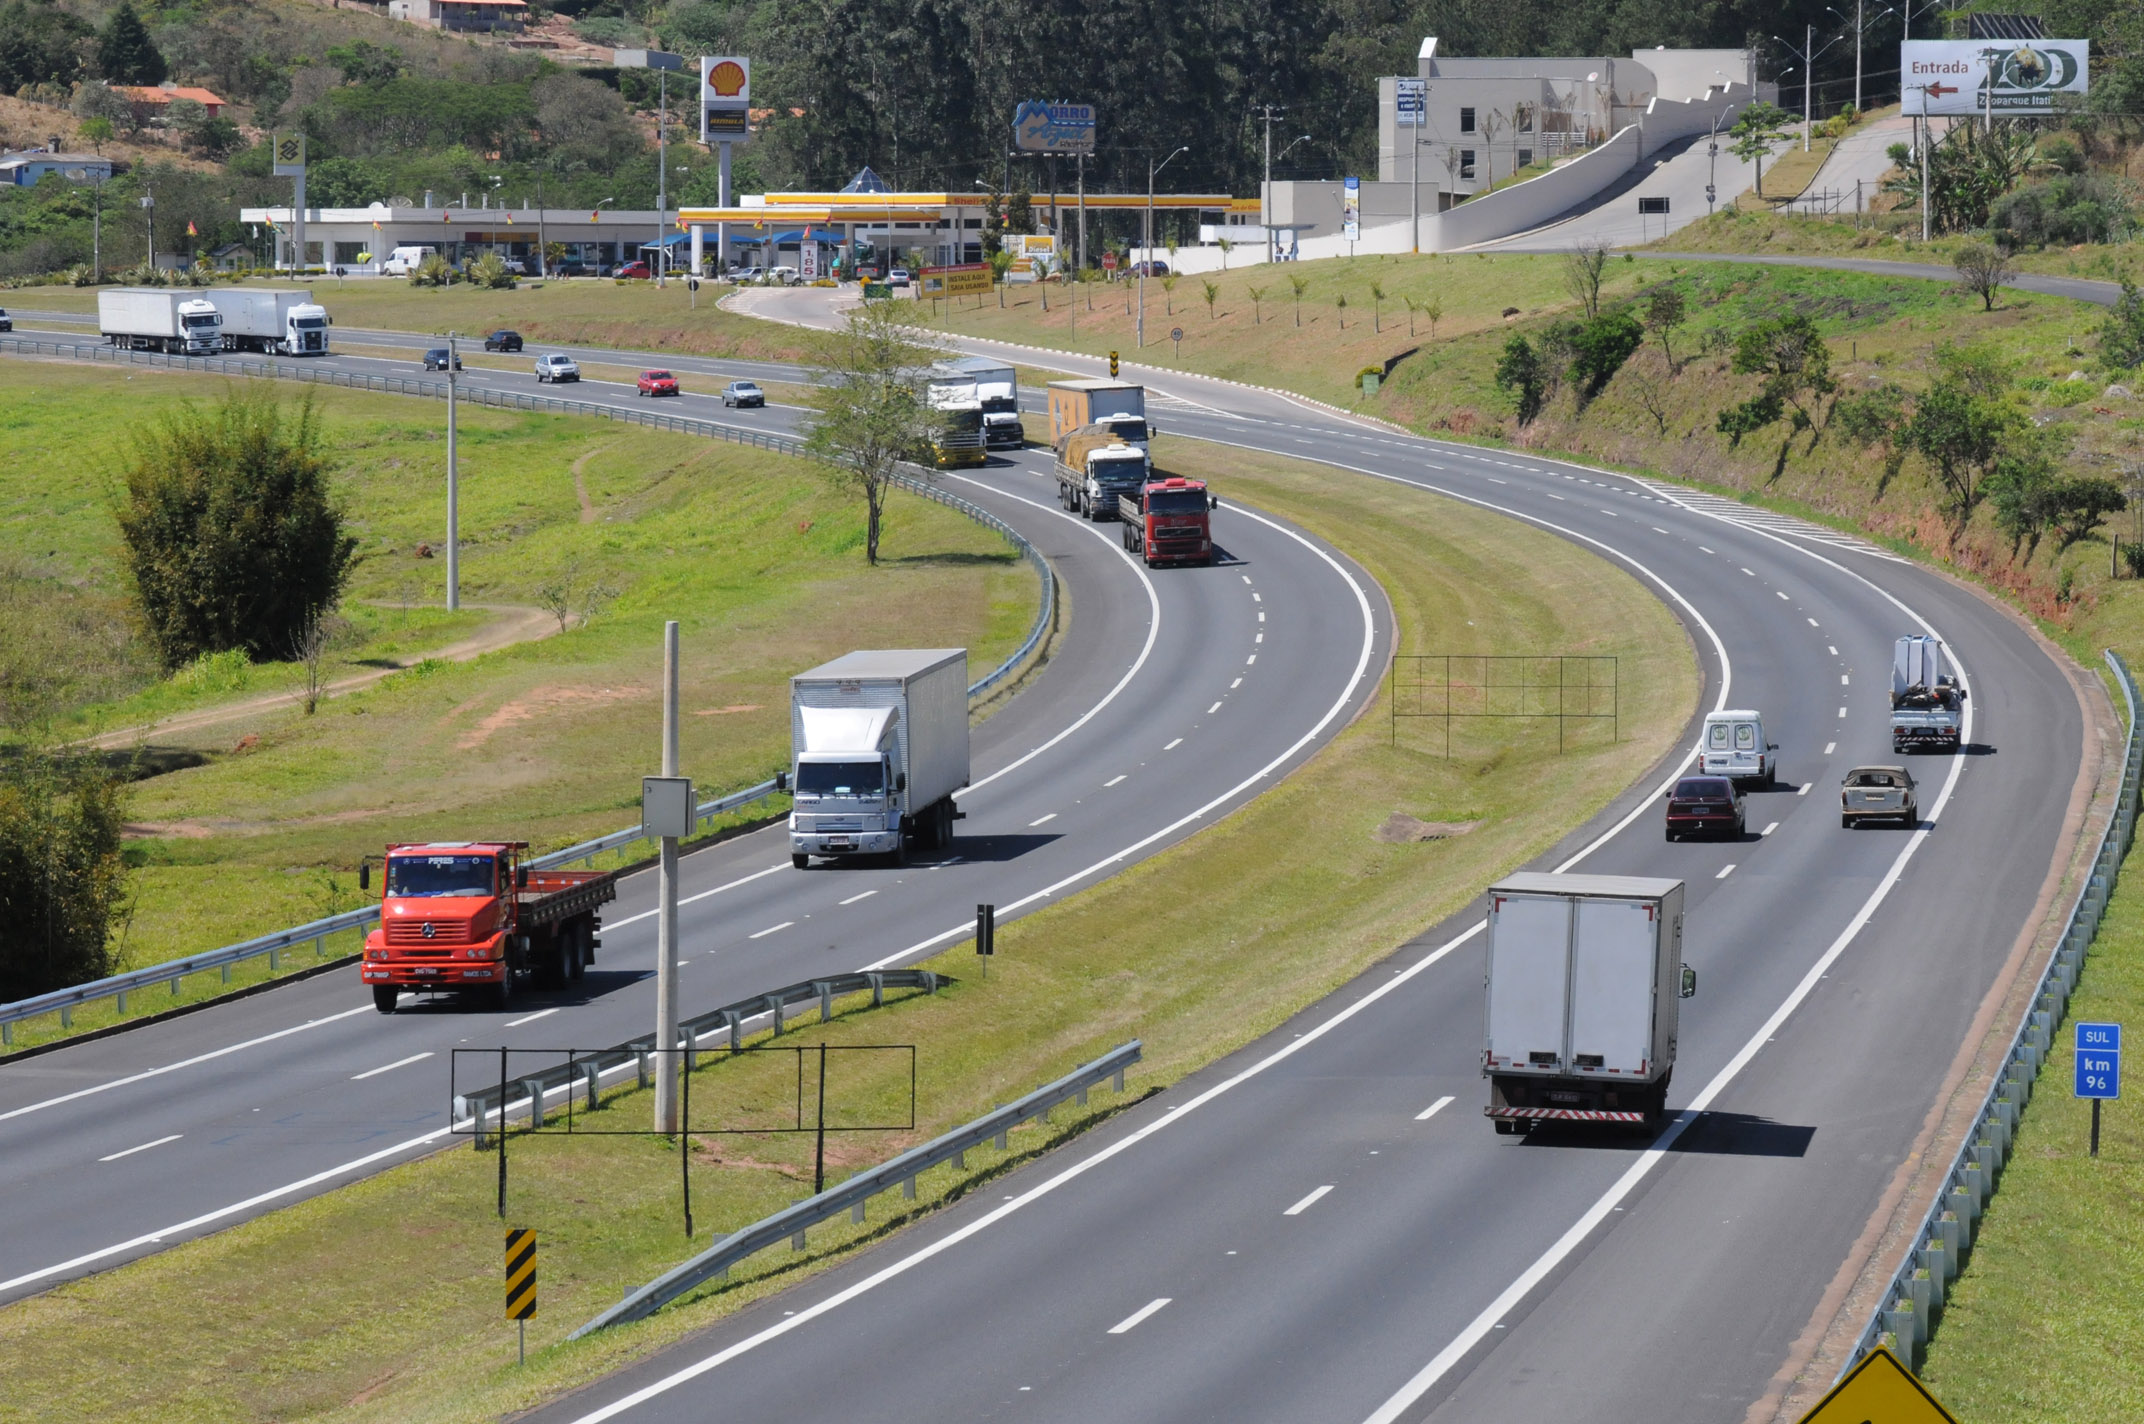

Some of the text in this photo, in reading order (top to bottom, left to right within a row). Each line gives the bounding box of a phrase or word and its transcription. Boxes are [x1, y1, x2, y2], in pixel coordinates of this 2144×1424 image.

[1912, 60, 1969, 74] Entrada
[1978, 48, 2078, 89] ZOO
[1979, 95, 2030, 106] Zoparque
[1012, 98, 1090, 127] MORRO
[428, 857, 455, 865] PERES
[2085, 1031, 2110, 1043] SUL
[2084, 1057, 2110, 1071] km
[2086, 1075, 2107, 1090] 96
